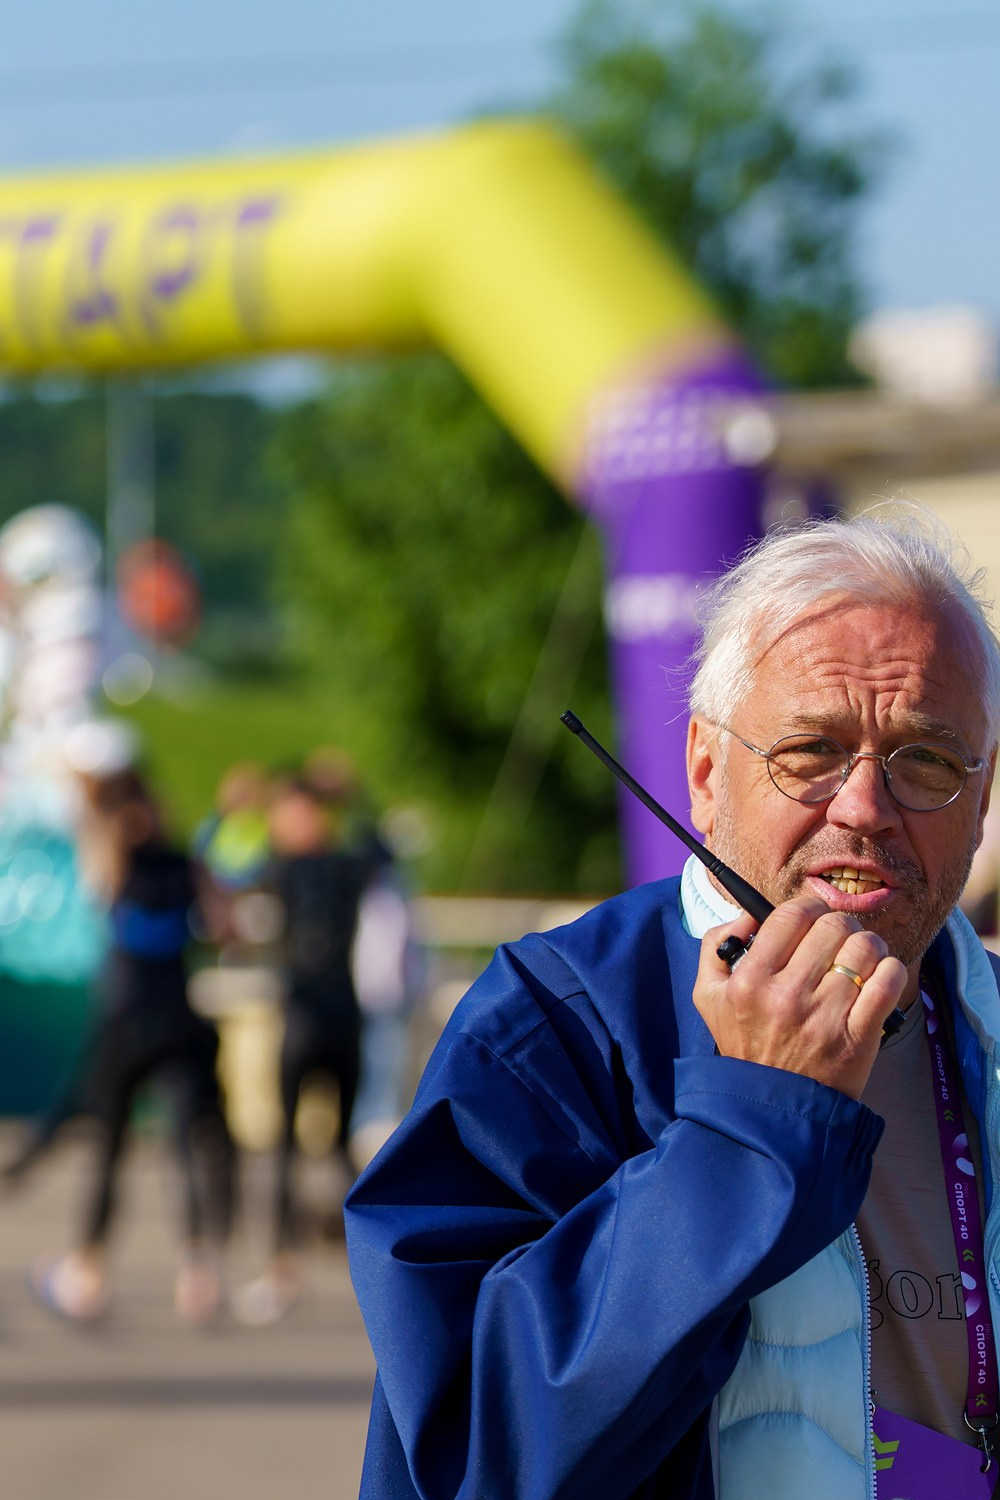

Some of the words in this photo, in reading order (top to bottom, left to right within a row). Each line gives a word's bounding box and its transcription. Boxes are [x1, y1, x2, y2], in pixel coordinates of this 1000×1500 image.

[935, 1044, 947, 1084] СПОРТ
[941, 1085, 949, 1100] 40
[954, 1182, 967, 1223] СПОРТ
[960, 1224, 969, 1240] 40
[975, 1324, 987, 1366] СПОРТ
[977, 1368, 987, 1384] 40
